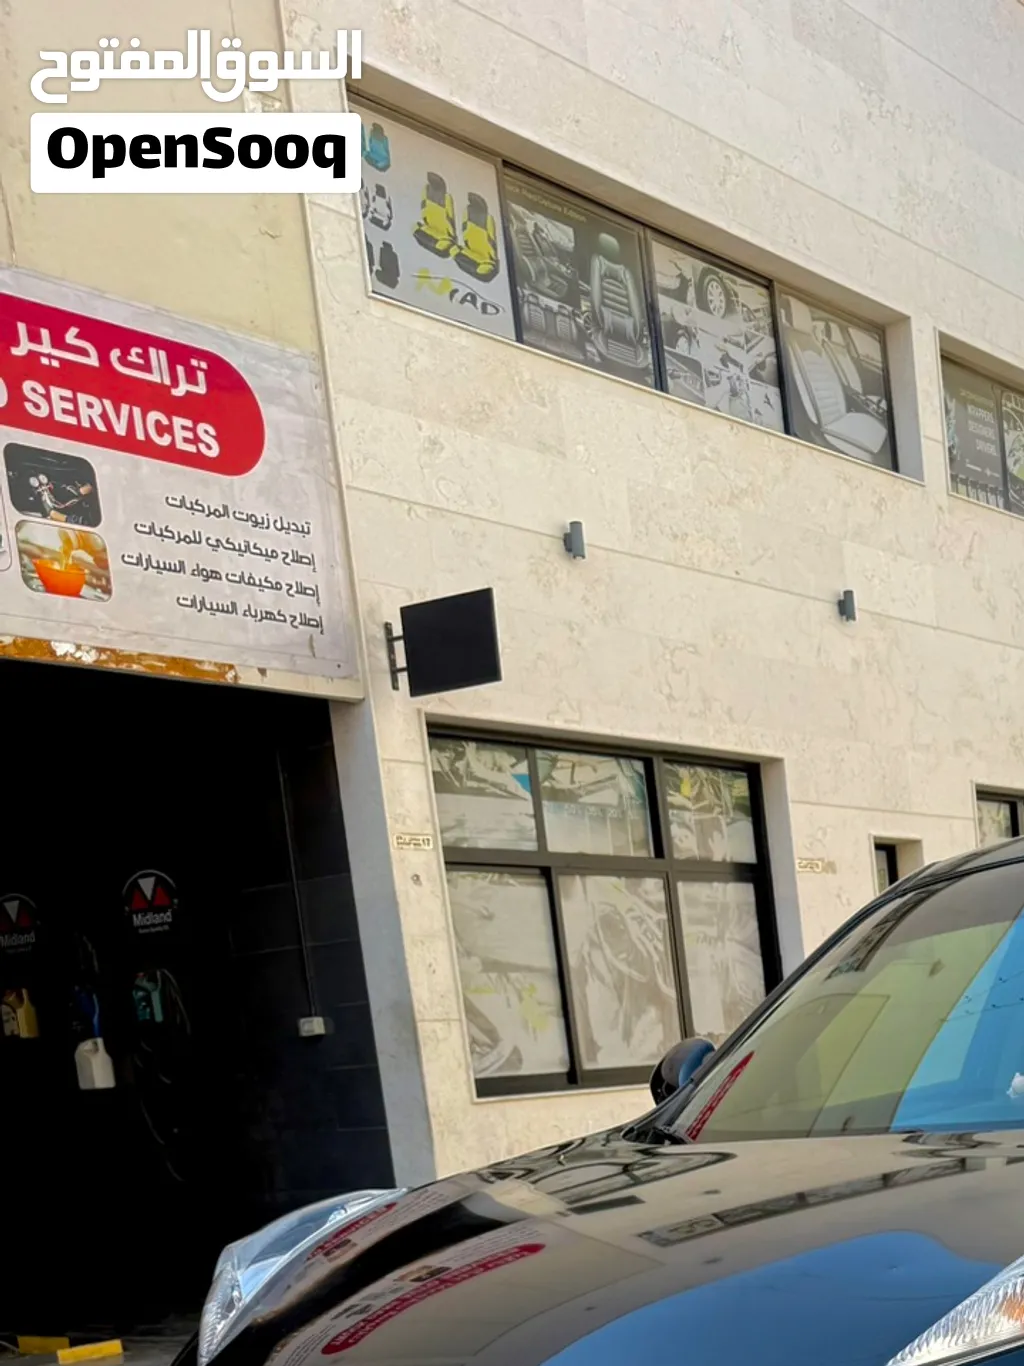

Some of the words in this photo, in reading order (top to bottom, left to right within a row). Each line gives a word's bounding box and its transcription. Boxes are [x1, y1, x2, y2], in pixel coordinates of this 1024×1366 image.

[10, 321, 100, 368] كير
[109, 346, 208, 397] تراك
[22, 379, 220, 458] SERVICES
[165, 495, 230, 519] المركبات
[232, 511, 270, 531] زيوت
[273, 517, 311, 538] تبديل
[134, 521, 202, 546] للمركبات
[206, 536, 279, 562] ميكانيكي
[121, 552, 187, 575] السيارات
[191, 564, 222, 582] هواء
[281, 550, 317, 573] إصلاح
[225, 570, 283, 593] مكيفات
[176, 594, 238, 617] السيارات
[285, 582, 321, 607] إصلاح
[242, 603, 287, 624] كهرباء
[289, 613, 325, 635] إصلاح
[132, 908, 173, 928] Midland
